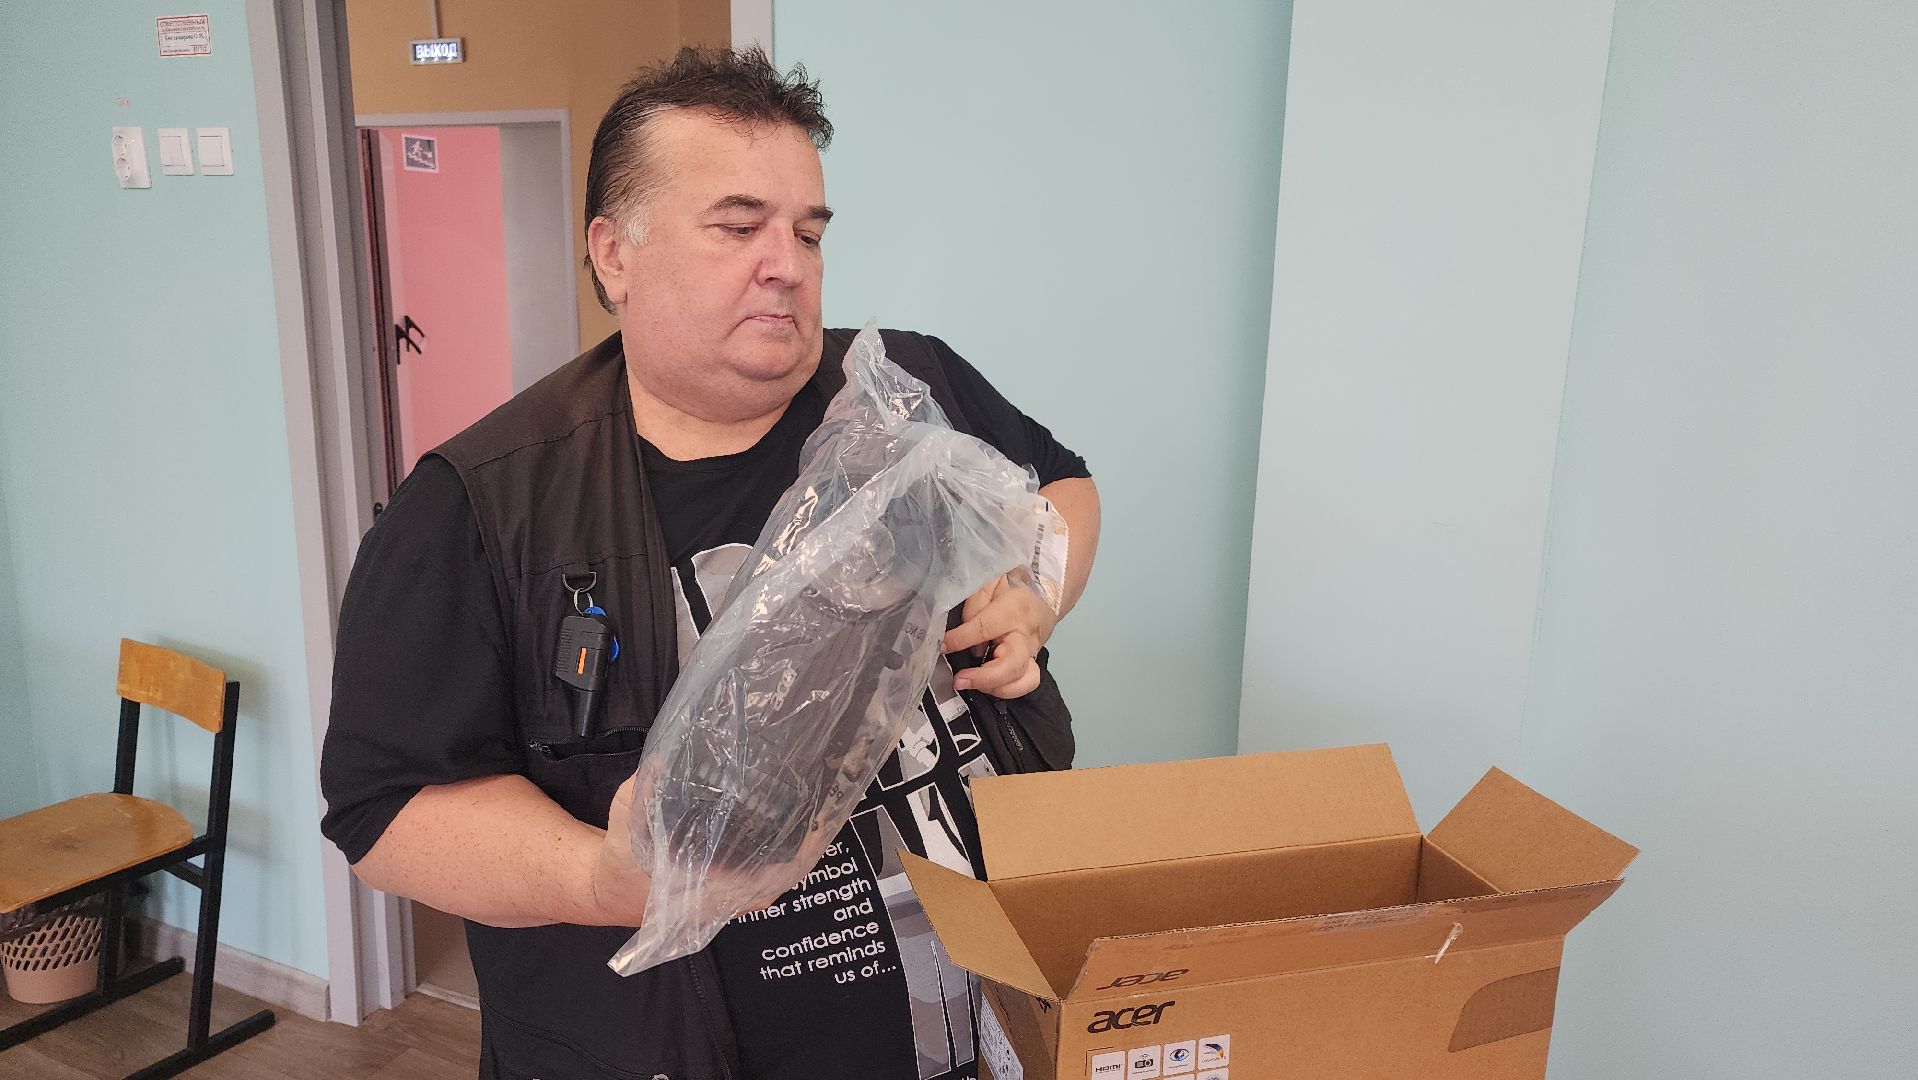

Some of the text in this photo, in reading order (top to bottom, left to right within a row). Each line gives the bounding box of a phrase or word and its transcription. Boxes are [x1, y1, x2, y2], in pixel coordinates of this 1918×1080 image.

[415, 42, 458, 59] ВЫХОД
[792, 877, 872, 912] strength
[833, 897, 874, 921] and
[761, 921, 880, 961] confidence
[759, 939, 886, 981] that reminds
[834, 959, 897, 984] us of...
[1096, 968, 1190, 991] acer
[1087, 1000, 1176, 1034] acer
